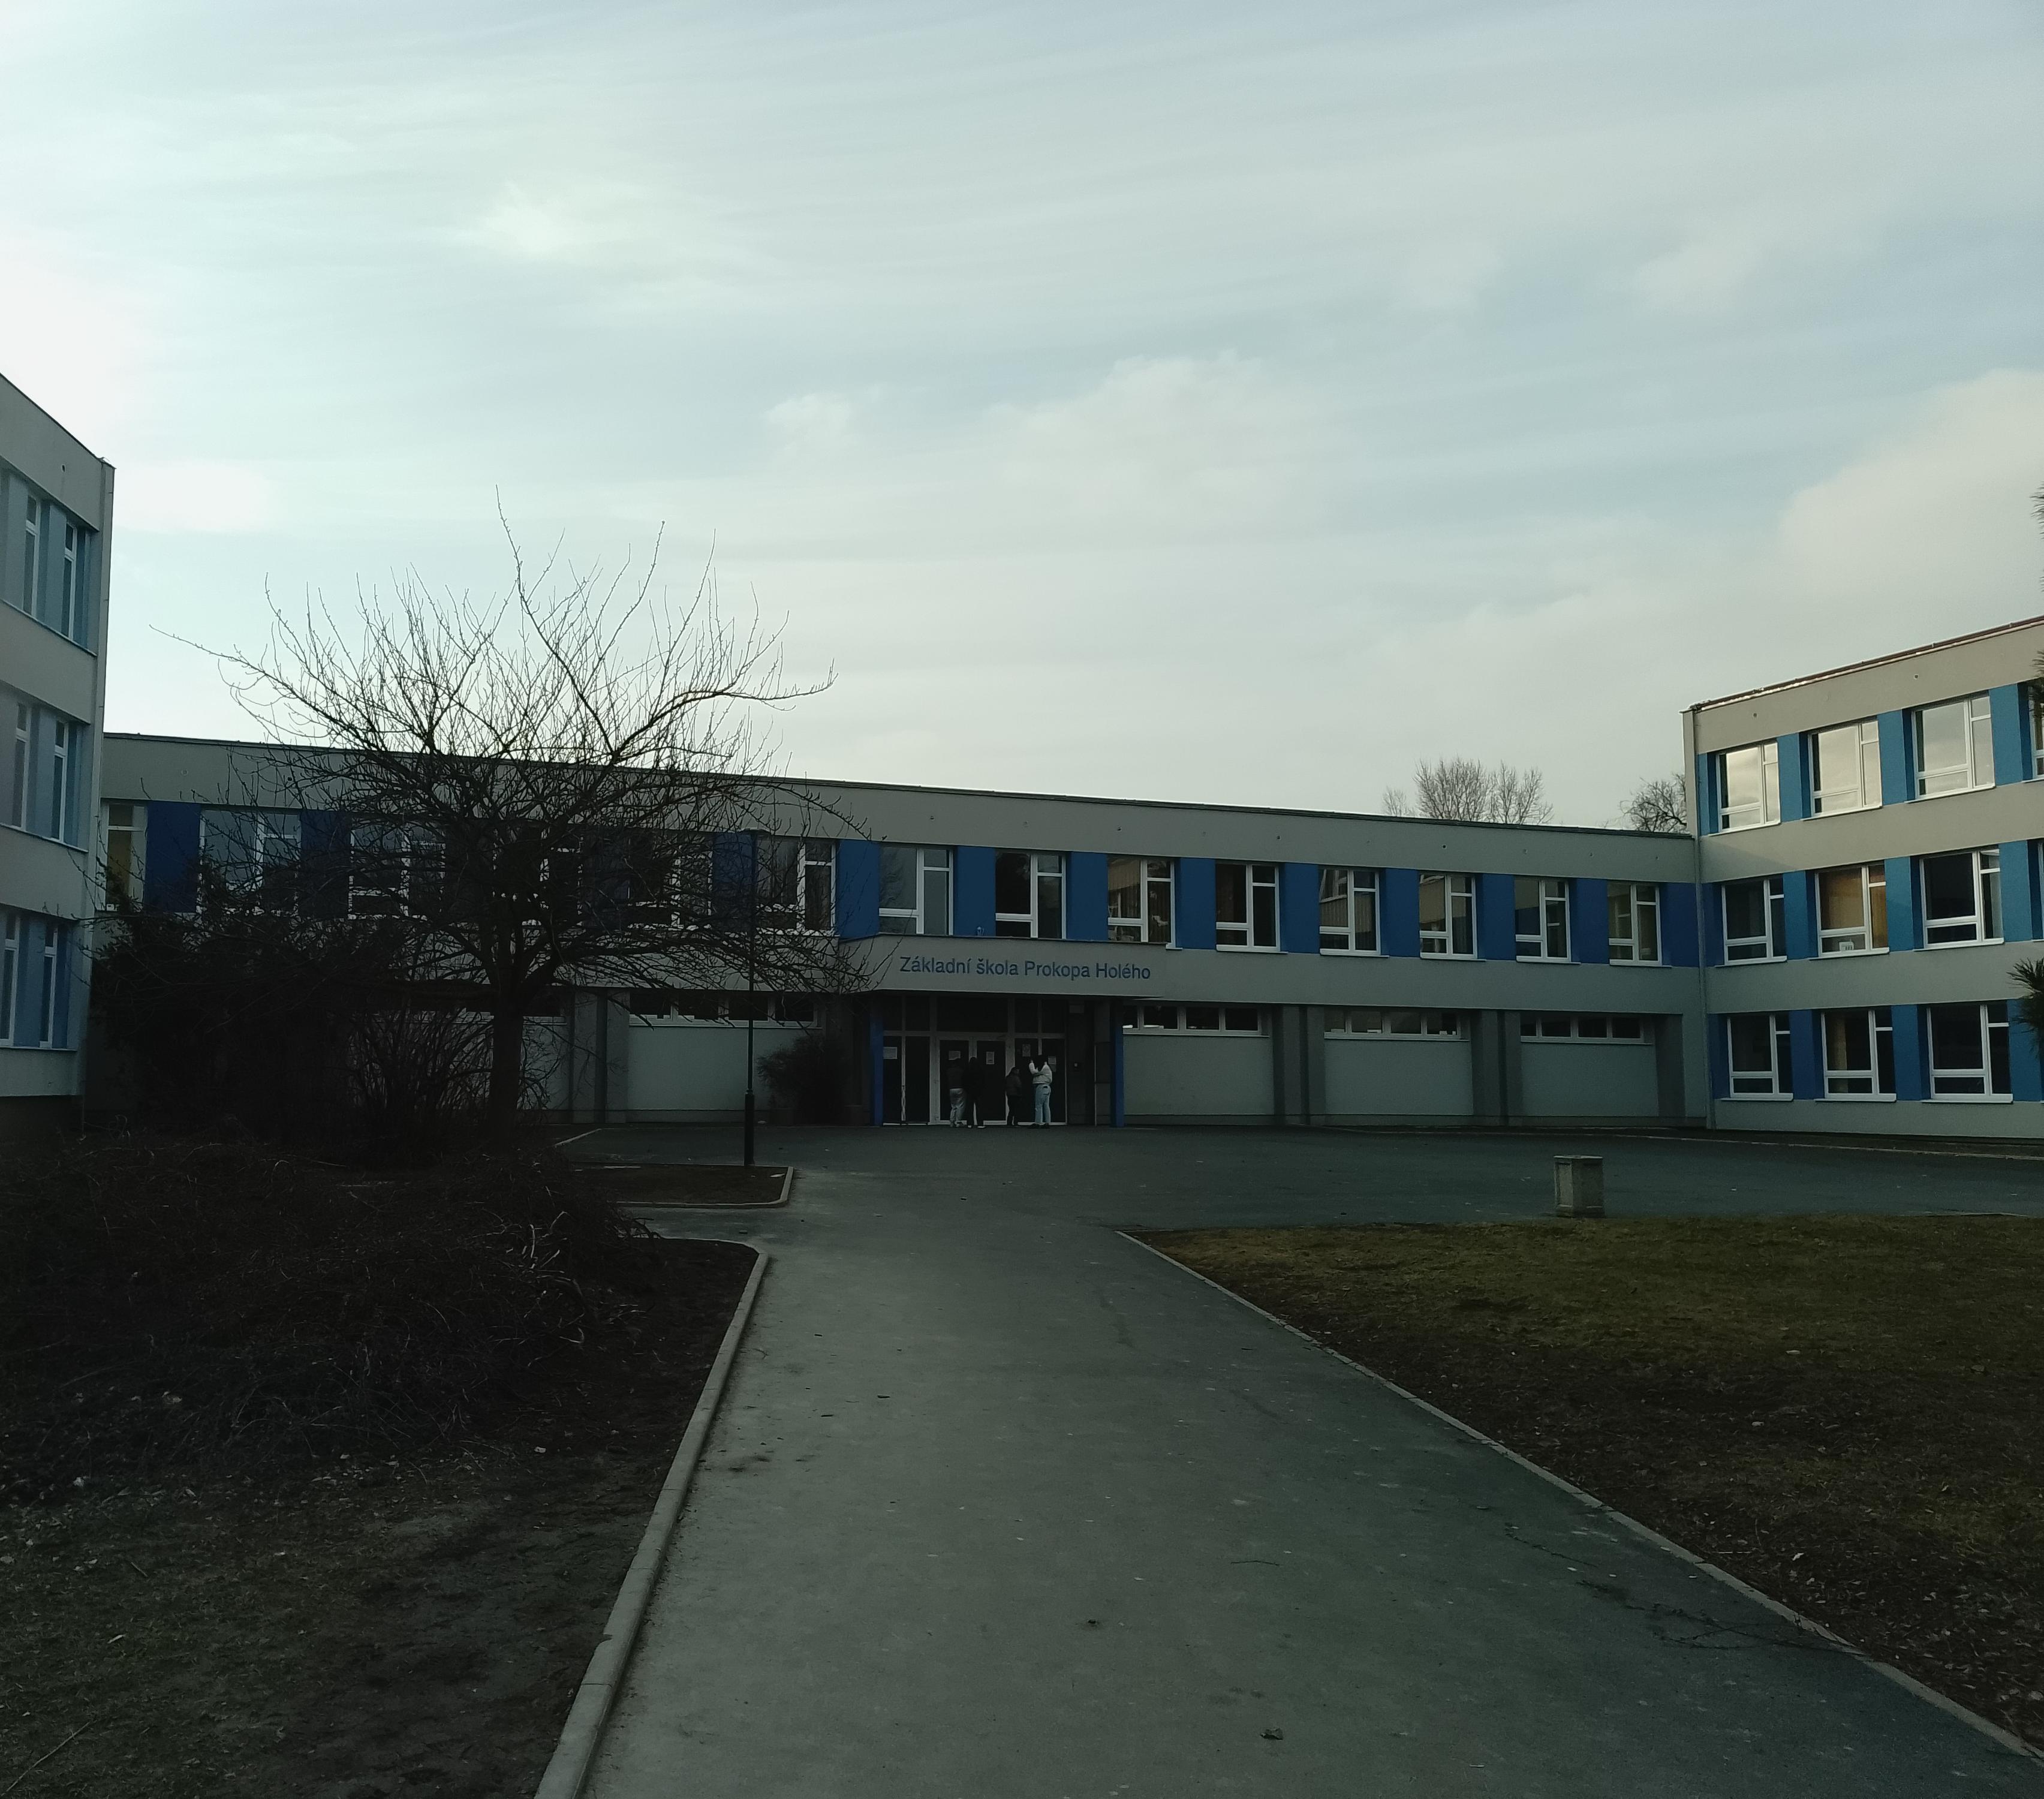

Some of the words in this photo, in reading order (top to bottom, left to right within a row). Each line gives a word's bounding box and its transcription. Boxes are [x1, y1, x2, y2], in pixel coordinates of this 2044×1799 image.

[900, 956, 971, 973] Základní
[976, 959, 1019, 975] škola
[1025, 961, 1089, 980] Prokopa
[1096, 962, 1151, 979] Holého
